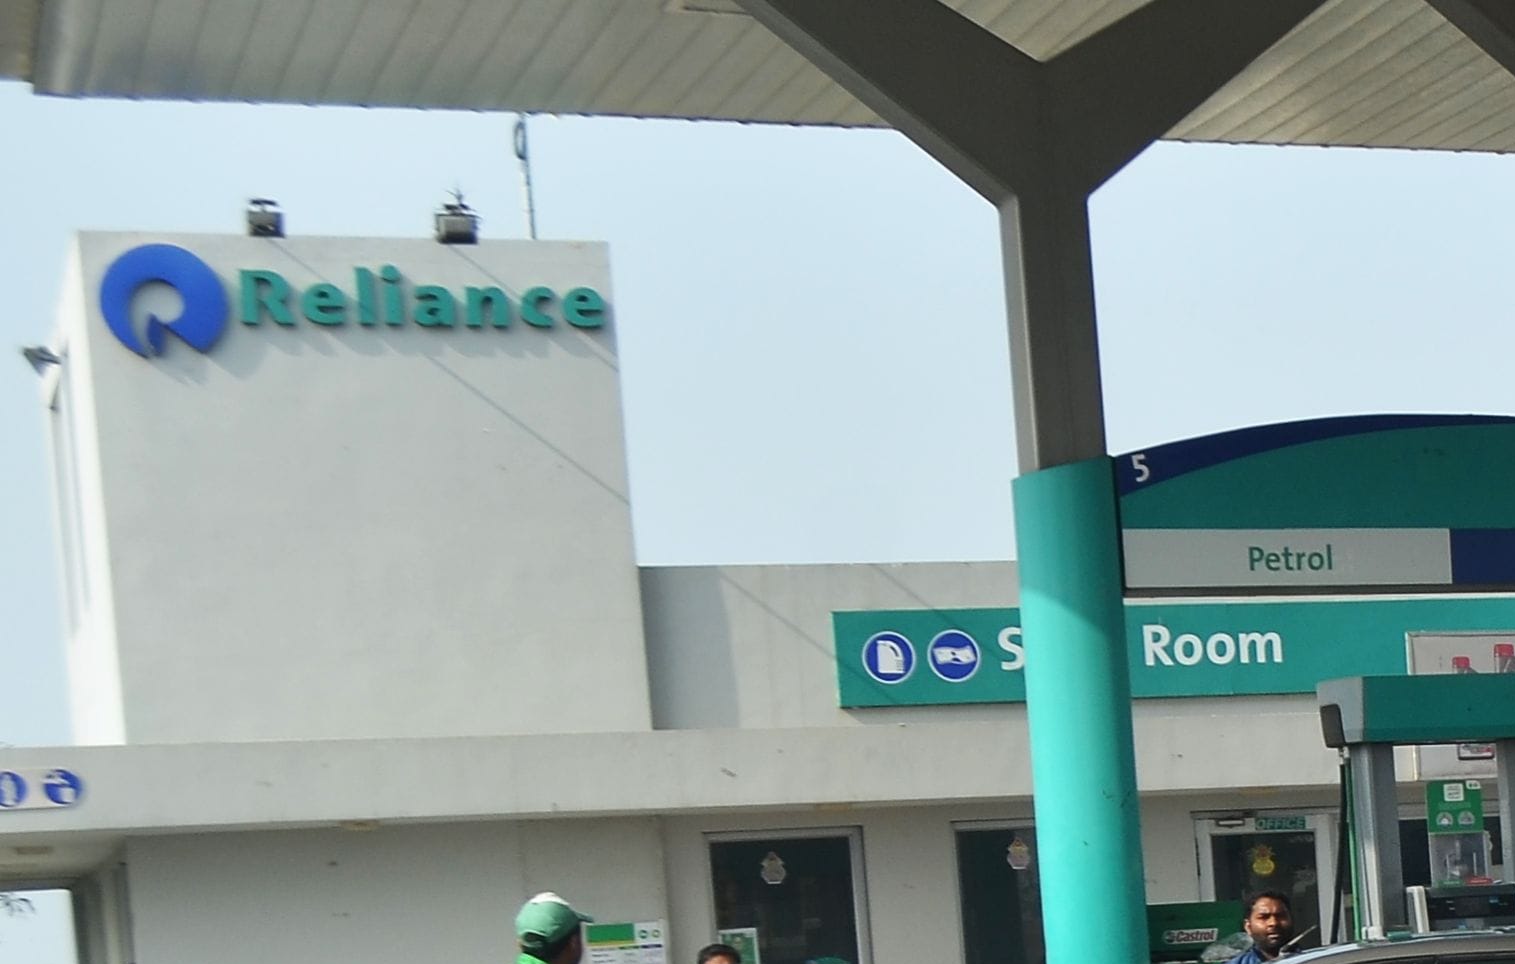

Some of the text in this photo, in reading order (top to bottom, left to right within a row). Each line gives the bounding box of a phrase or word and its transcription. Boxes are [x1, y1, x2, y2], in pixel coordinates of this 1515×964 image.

[239, 264, 605, 328] Reliance
[1131, 453, 1150, 482] 5
[1248, 544, 1333, 572] Petrol
[1142, 624, 1284, 666] Room
[1255, 818, 1305, 829] OFFICE
[1175, 929, 1215, 943] Castrol
